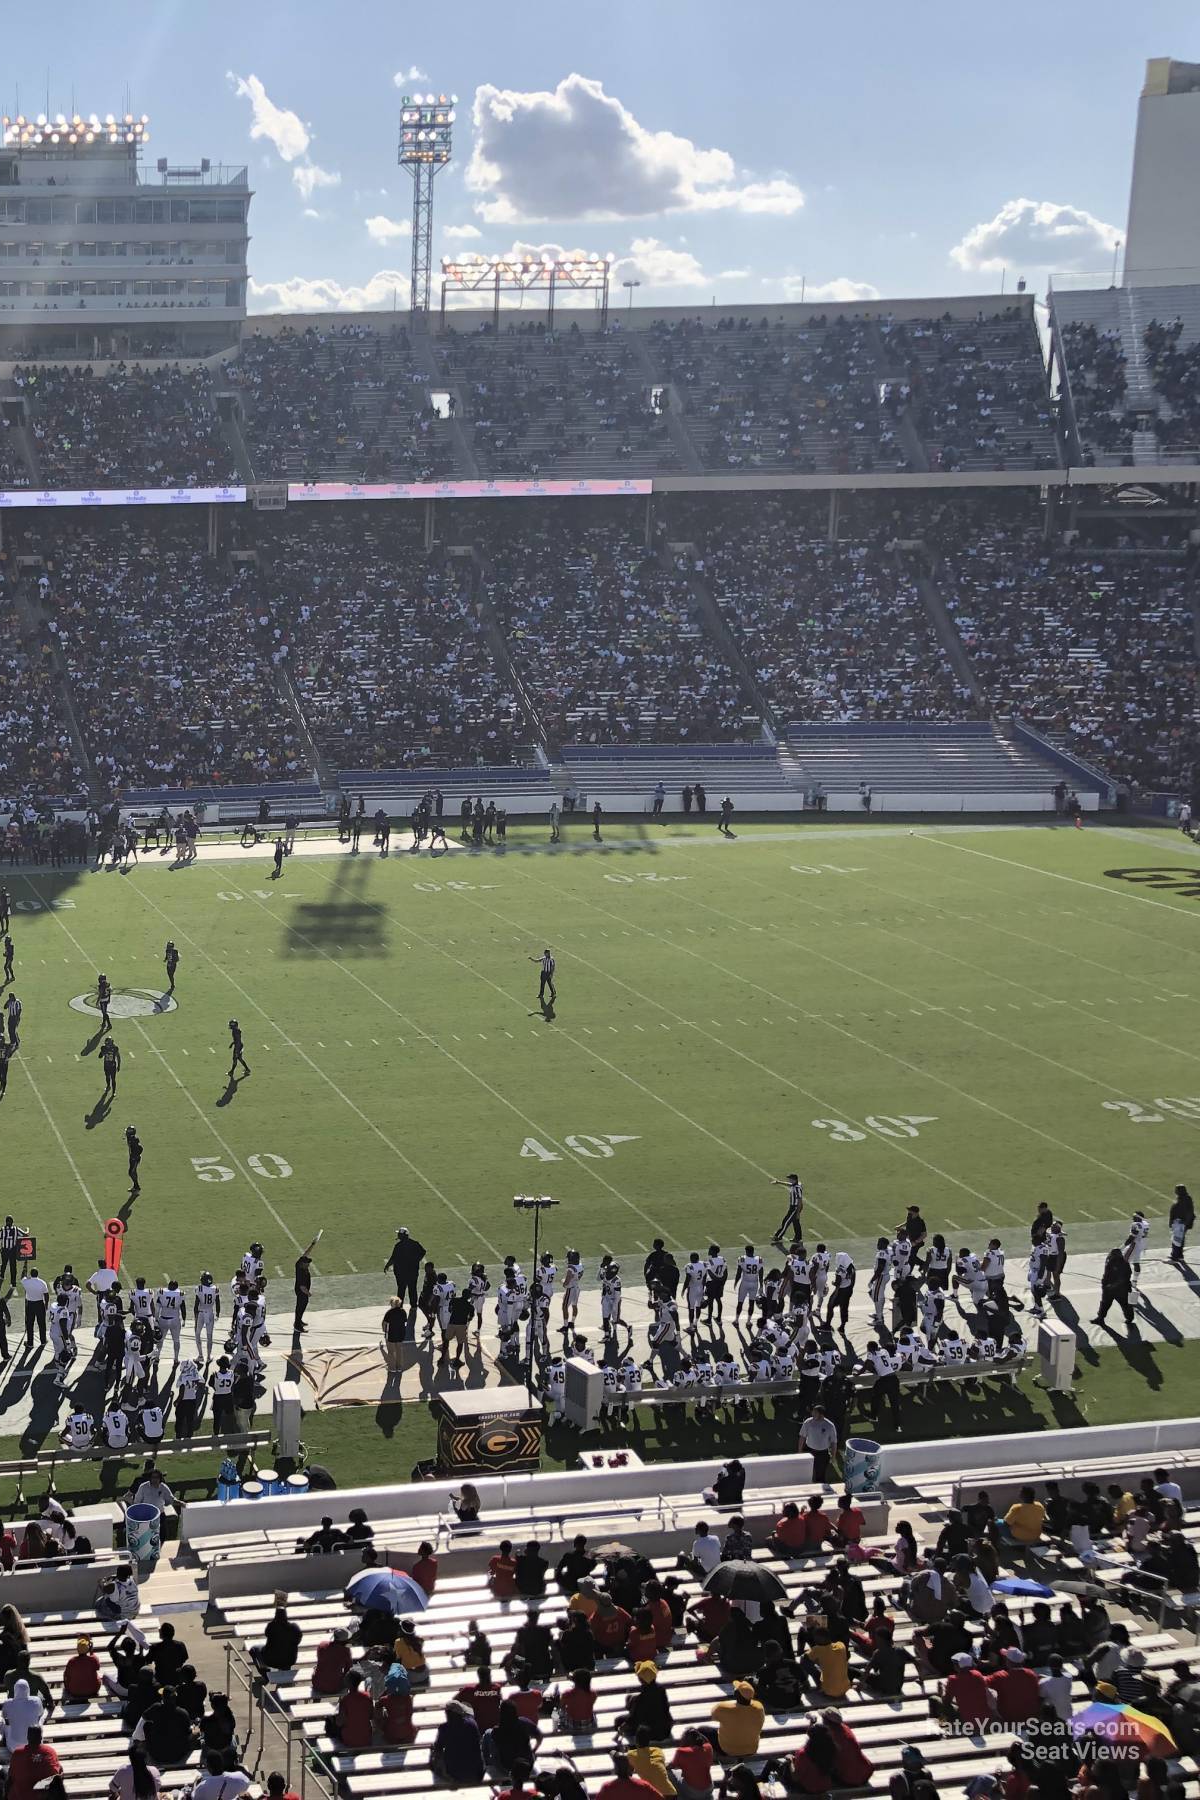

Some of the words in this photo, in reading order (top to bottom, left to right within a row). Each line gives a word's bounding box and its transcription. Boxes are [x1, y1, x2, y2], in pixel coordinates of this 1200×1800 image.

[811, 1114, 919, 1142] 30
[518, 1134, 617, 1161] 40
[191, 1152, 294, 1182] 50
[19, 1239, 33, 1255] 3
[746, 1264, 757, 1275] 58
[794, 1265, 806, 1277] 34
[515, 1283, 525, 1296] 96
[138, 1296, 147, 1308] 16
[166, 1296, 175, 1308] 74
[203, 1293, 212, 1304] 18
[950, 1347, 963, 1359] 59
[984, 1344, 994, 1356] 98
[552, 1371, 564, 1384] 49
[629, 1370, 641, 1383] 23
[729, 1368, 738, 1380] 46
[781, 1365, 792, 1377] 32
[604, 1373, 616, 1386] 29
[151, 1408, 158, 1422] 9
[75, 1422, 88, 1435] 50
[113, 1416, 120, 1429] 6
